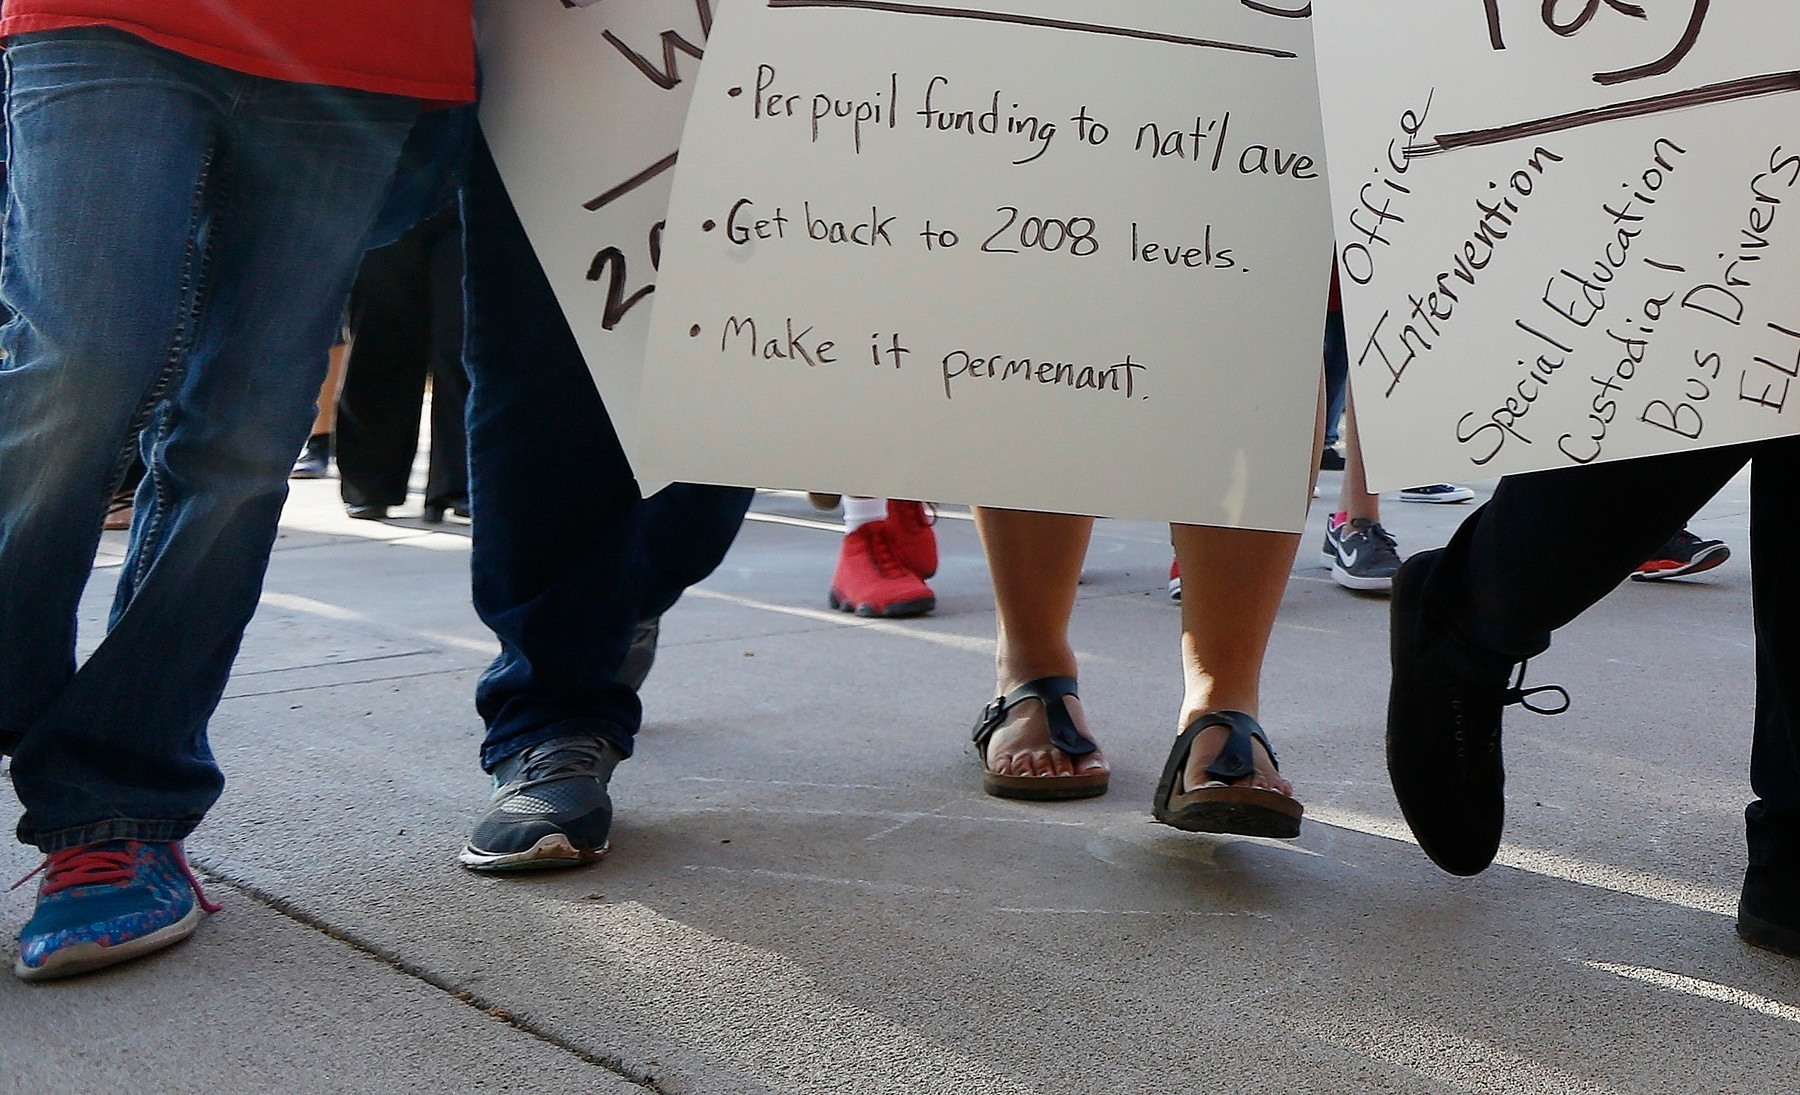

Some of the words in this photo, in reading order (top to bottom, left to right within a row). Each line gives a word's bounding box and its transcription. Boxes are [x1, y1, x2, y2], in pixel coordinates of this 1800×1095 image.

[753, 64, 802, 121] Per
[811, 72, 898, 154] pupil
[916, 75, 1057, 166] funding
[1071, 105, 1111, 148] to
[1341, 87, 1435, 286] Office
[725, 198, 790, 247] Get
[806, 200, 894, 249] back
[917, 219, 960, 253] to
[979, 206, 1101, 258] 2008
[1128, 226, 1253, 277] levels.
[1357, 145, 1565, 399] Intervention
[1455, 318, 1574, 466] Special
[1541, 137, 1687, 328] Education
[1636, 348, 1721, 440] Bus
[1680, 145, 1800, 326] Drivers
[720, 316, 839, 367] Make
[868, 331, 912, 371] it
[941, 349, 1150, 402] permenant.
[1557, 257, 1686, 465] Custodial
